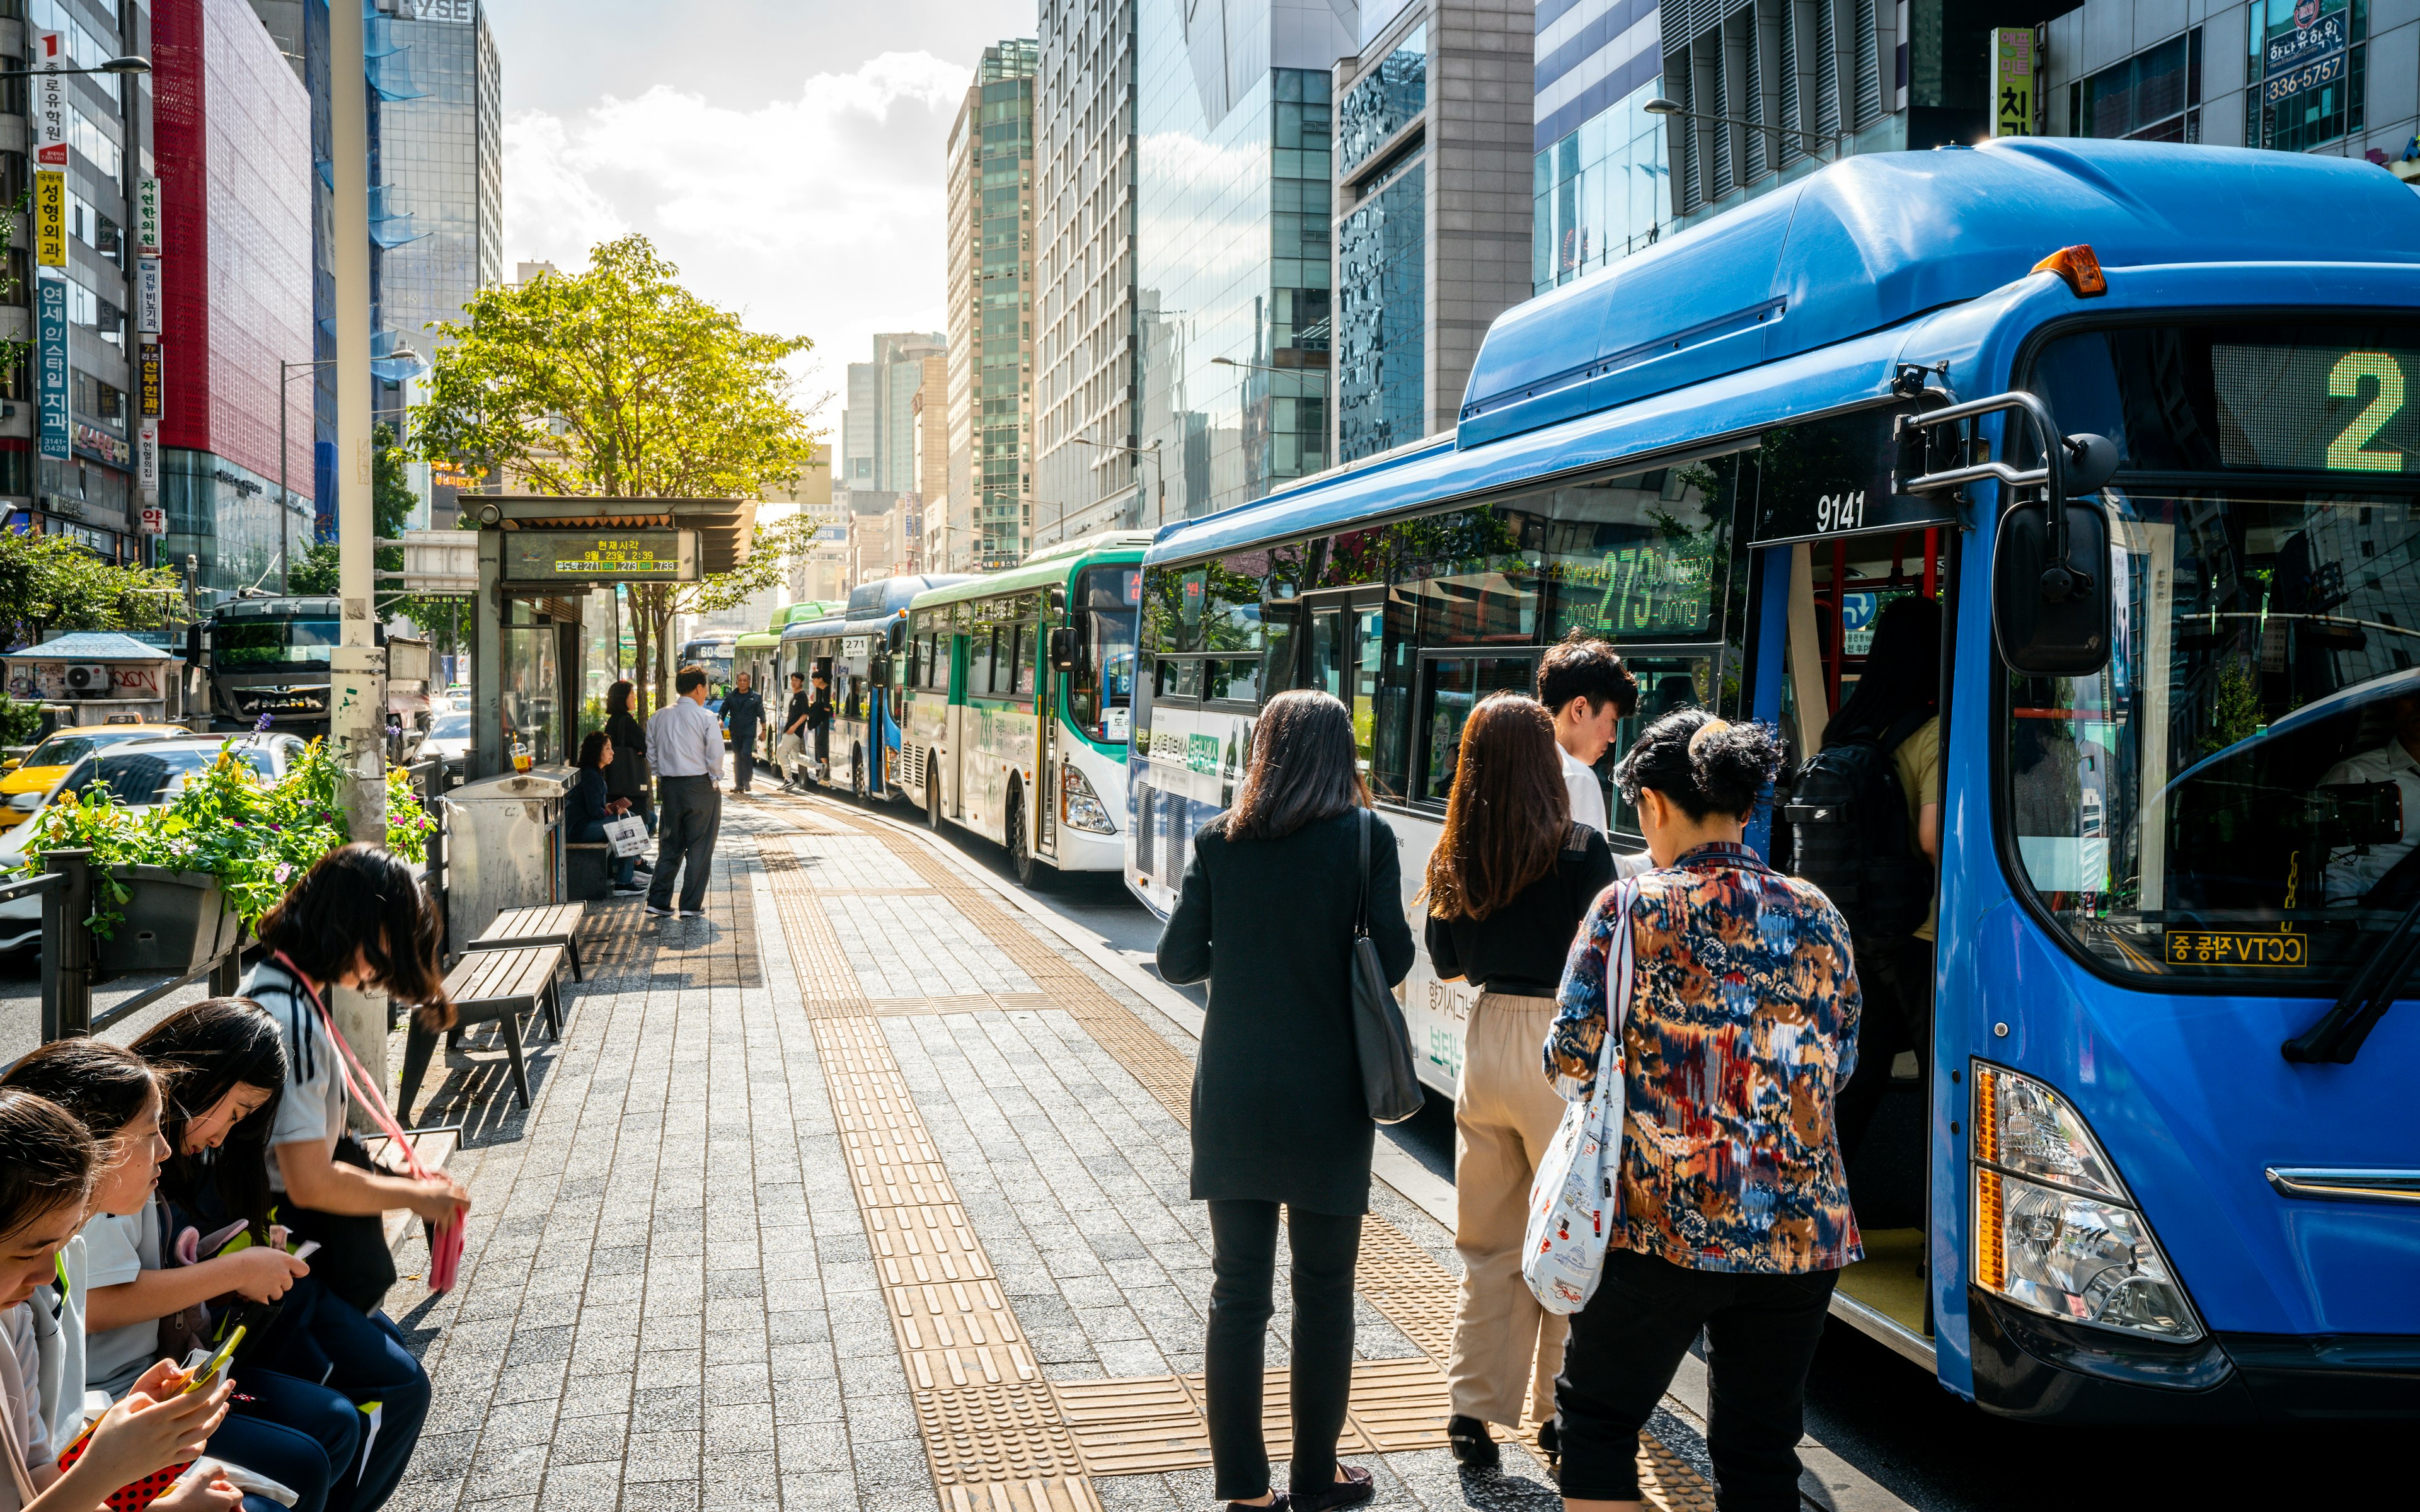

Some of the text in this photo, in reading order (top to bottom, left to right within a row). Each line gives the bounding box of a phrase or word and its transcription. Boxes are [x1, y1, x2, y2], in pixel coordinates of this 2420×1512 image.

[399, 0, 468, 20] RYSE
[2001, 32, 2031, 59] 애플
[2271, 21, 2342, 60] 하나유학원
[2001, 60, 2031, 82] 민트
[2269, 60, 2281, 69] Hana
[2270, 57, 2341, 100] 336-5757
[44, 62, 61, 141] 종로유학원
[42, 185, 61, 258] 성형외과
[141, 180, 156, 246] 자연한의원
[43, 287, 67, 431] 연세 인스타일 치과
[141, 353, 159, 361] 리즈
[142, 362, 158, 410] 산부인과
[143, 442, 152, 478] 헌혈의집
[142, 510, 162, 527] 약
[1817, 490, 1865, 532] 9141
[812, 530, 834, 539] 성화재
[585, 551, 653, 561] 9월 23일 2:39
[598, 541, 639, 551] 현재시각
[1596, 546, 1654, 630] 273
[700, 646, 719, 657] 604
[846, 640, 864, 648] 271
[1847, 644, 1871, 653] 전후P
[1395, 838, 1404, 847] ENS
